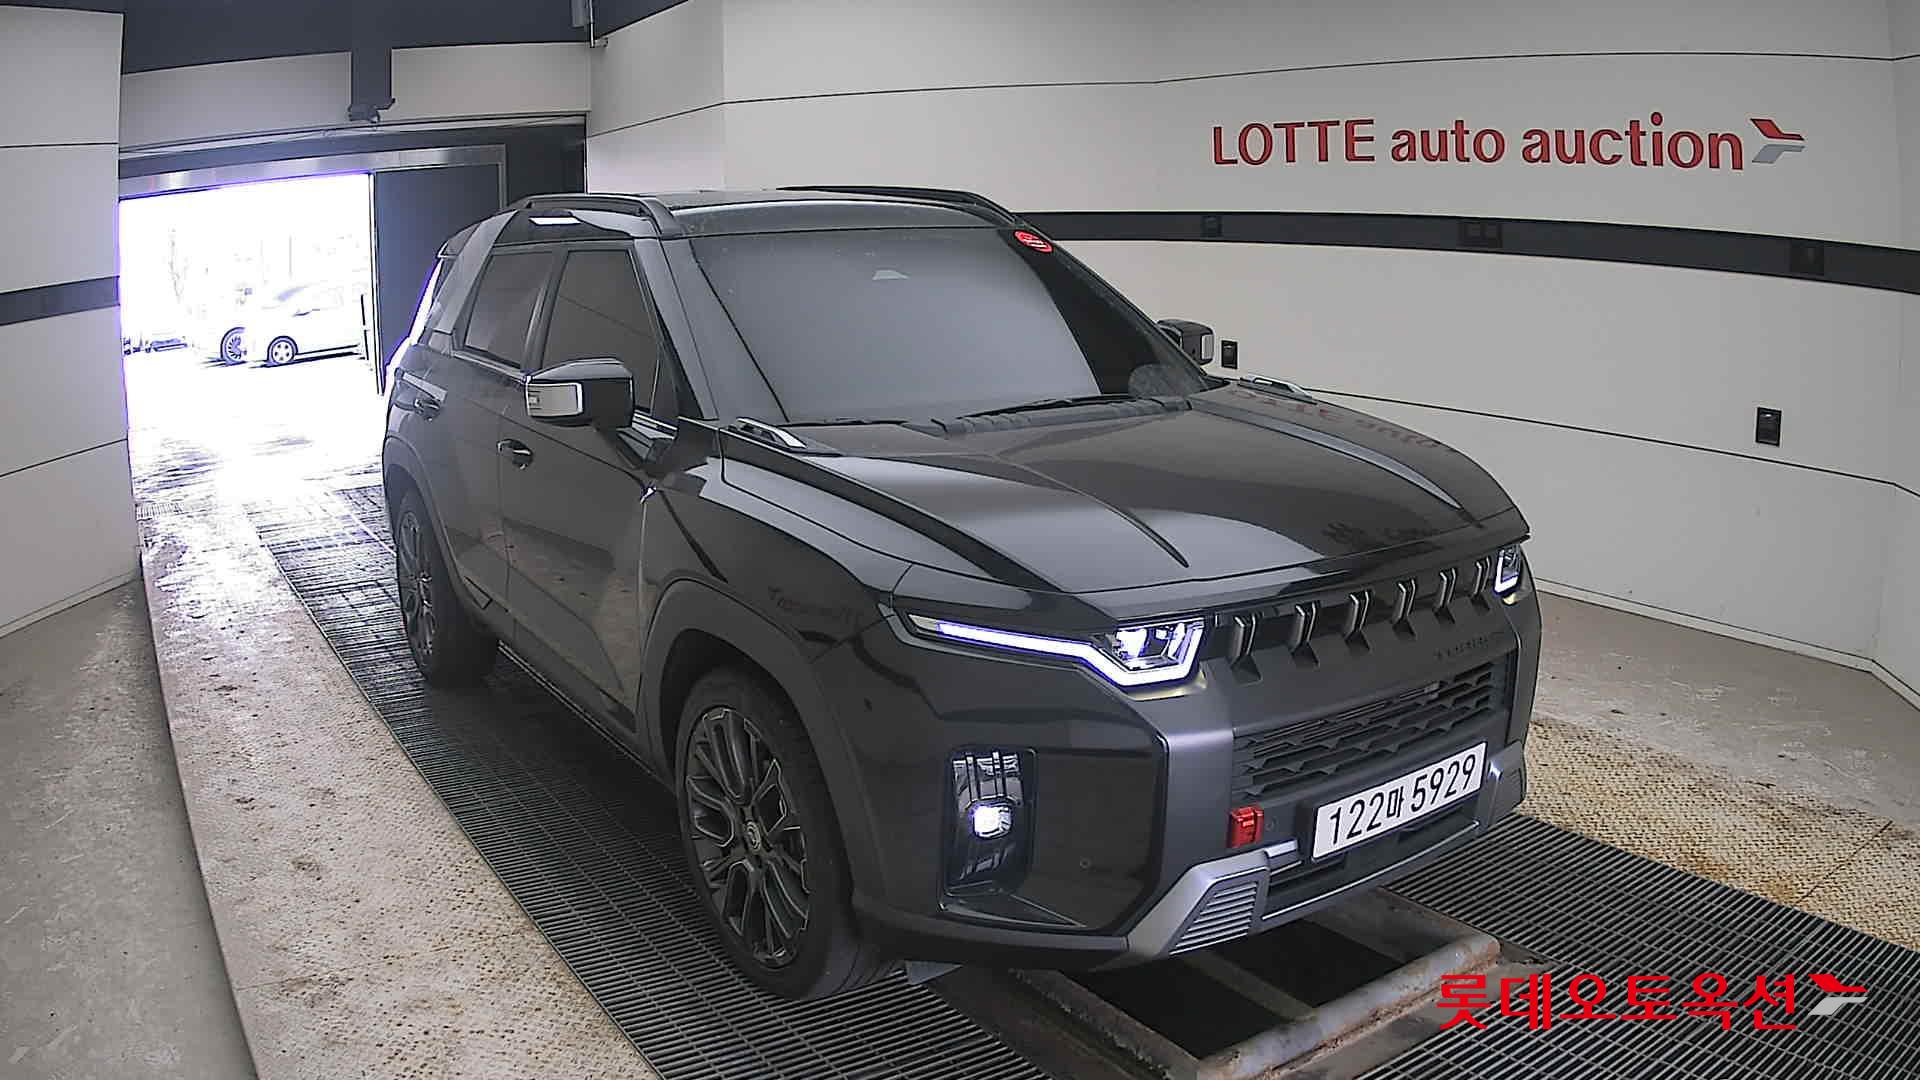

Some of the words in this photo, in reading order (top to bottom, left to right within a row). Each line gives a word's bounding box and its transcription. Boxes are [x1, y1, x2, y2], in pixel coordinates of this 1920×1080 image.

[1212, 119, 1376, 166] LOTTE
[1390, 119, 1506, 164] auto
[1521, 112, 1744, 171] auction
[1411, 754, 1476, 812] 5929
